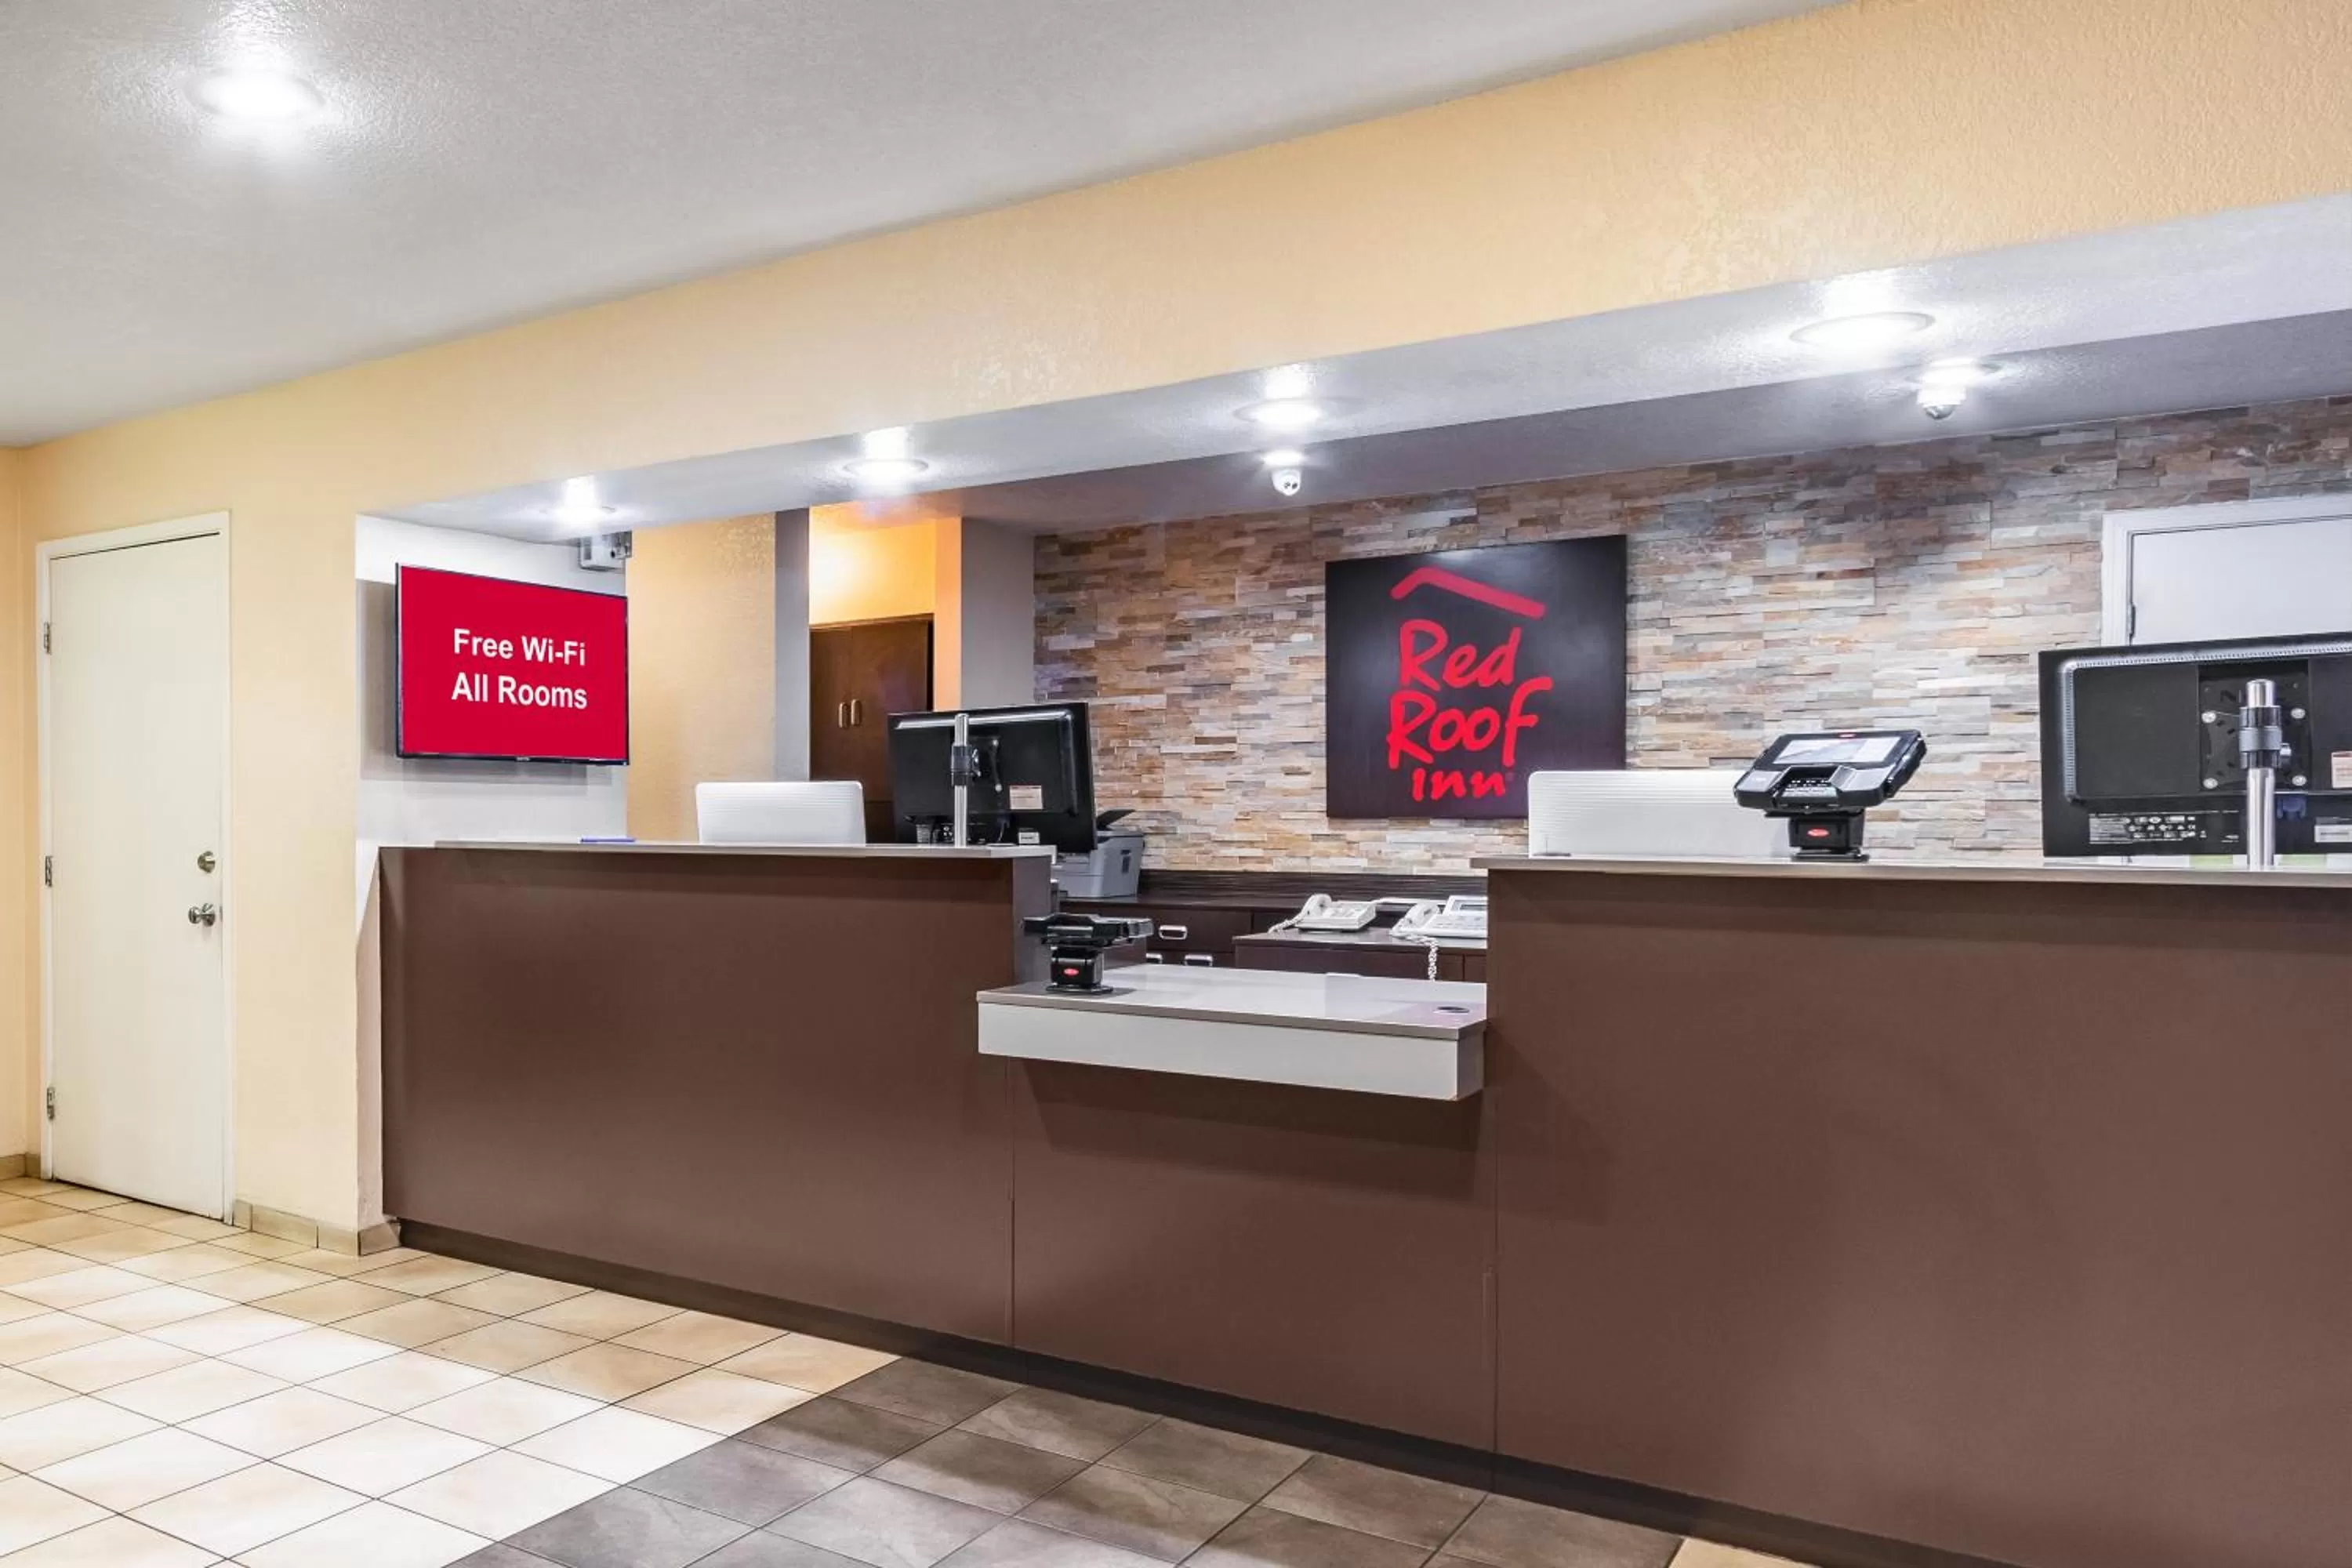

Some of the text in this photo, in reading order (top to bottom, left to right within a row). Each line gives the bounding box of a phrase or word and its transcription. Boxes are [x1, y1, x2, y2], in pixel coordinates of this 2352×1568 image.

[454, 628, 586, 666] Free Wi-Fi
[1399, 619, 1522, 691] Red
[451, 672, 587, 710] All Rooms
[1386, 677, 1554, 770] Roof
[1412, 768, 1506, 802] inn
